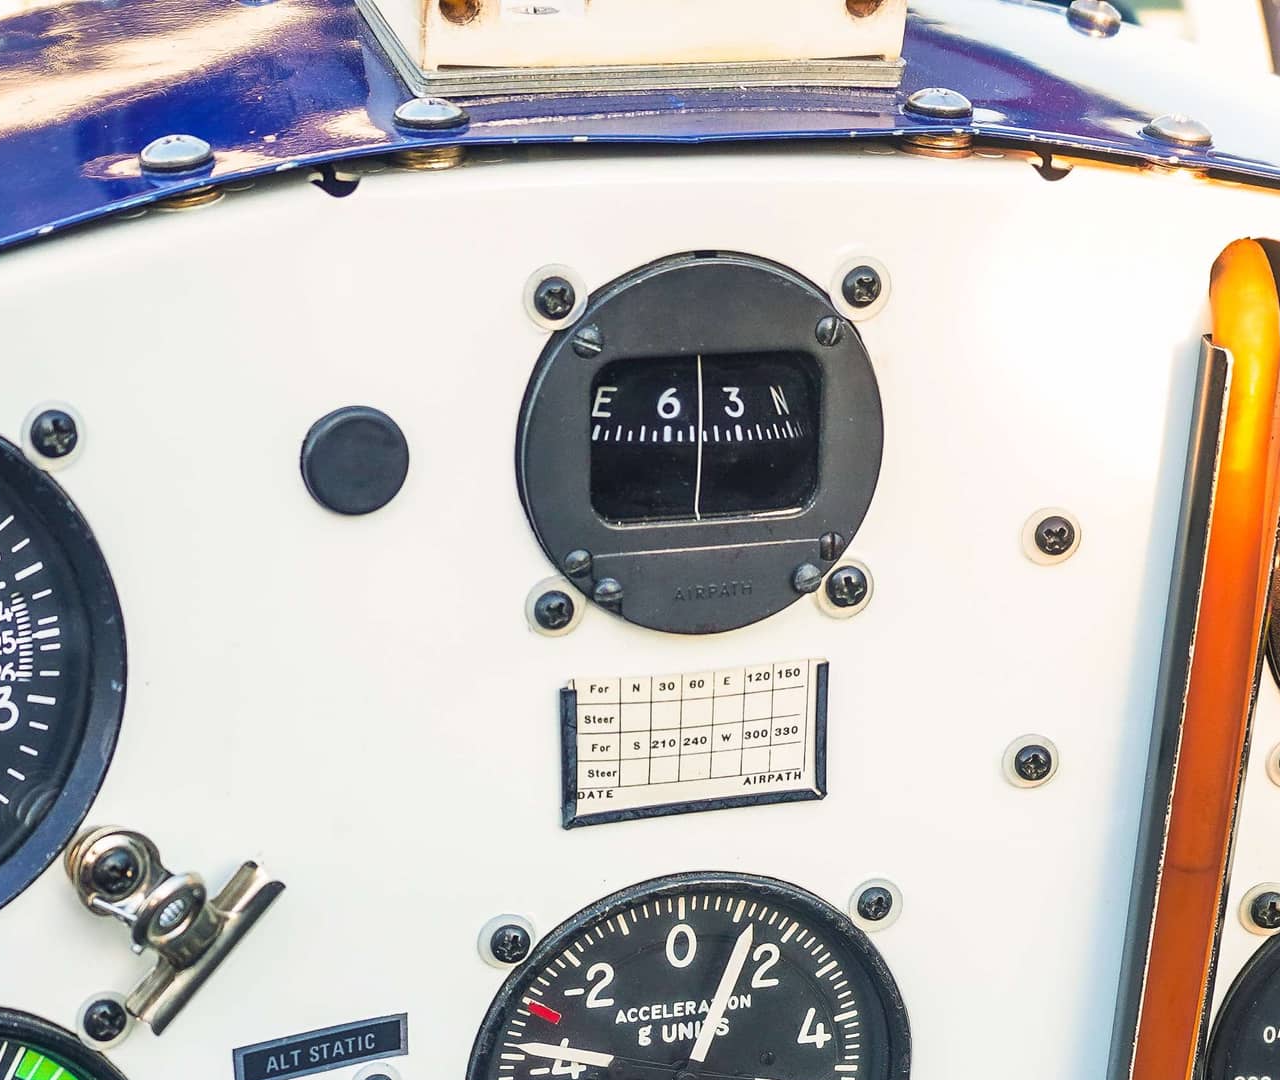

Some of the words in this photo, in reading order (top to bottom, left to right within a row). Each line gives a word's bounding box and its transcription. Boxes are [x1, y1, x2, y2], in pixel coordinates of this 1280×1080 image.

[592, 387, 617, 417] E
[657, 388, 681, 419] 6
[723, 387, 745, 418] 3
[769, 385, 790, 415] N
[675, 581, 753, 603] AIRPATH
[590, 684, 609, 694] For
[632, 684, 640, 692] N
[659, 682, 675, 691] 30
[689, 680, 705, 689] 60
[724, 677, 730, 685] E
[748, 672, 770, 682] 120
[584, 715, 615, 724] Steer
[592, 743, 611, 752] For
[634, 741, 640, 750] S
[652, 739, 676, 749] 210
[683, 736, 707, 746] 240
[722, 734, 732, 742] W
[744, 729, 768, 739] 300
[775, 726, 798, 736] 330
[577, 790, 614, 799] DATE
[744, 772, 802, 785] AIRPATH
[588, 769, 617, 778] Steer
[665, 924, 697, 968] 0
[752, 943, 779, 989] 2
[615, 994, 751, 1024] ACCELERAON
[798, 1008, 831, 1048] 4
[1263, 1027, 1276, 1043] 0
[266, 1051, 301, 1073] ALT
[310, 1033, 376, 1062] STATIC
